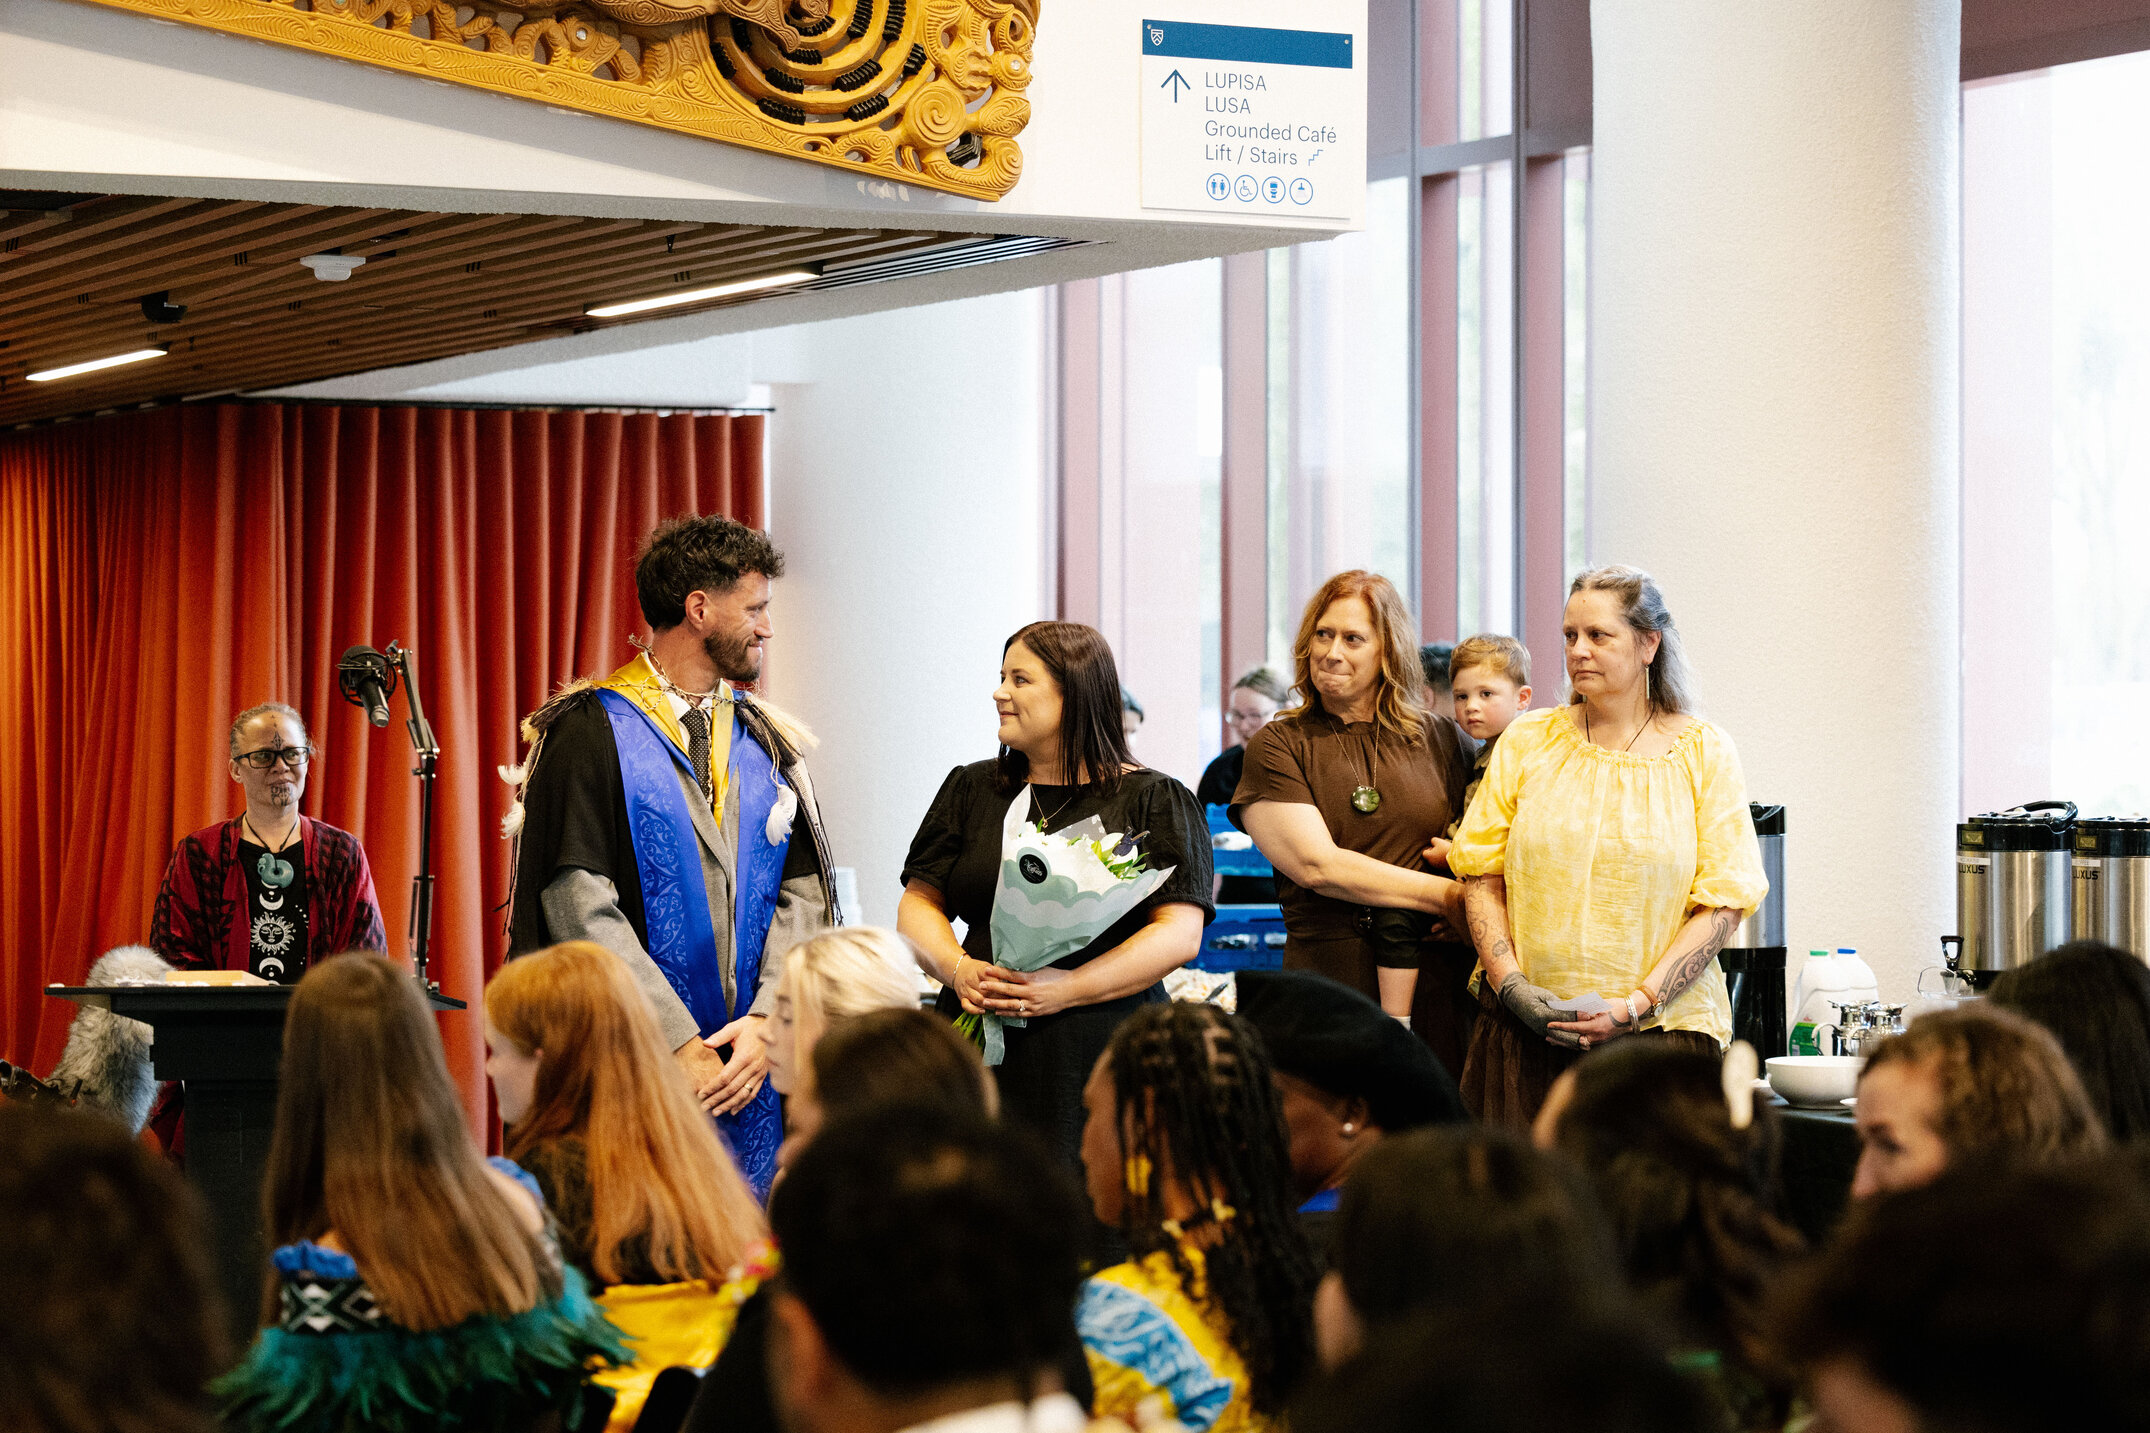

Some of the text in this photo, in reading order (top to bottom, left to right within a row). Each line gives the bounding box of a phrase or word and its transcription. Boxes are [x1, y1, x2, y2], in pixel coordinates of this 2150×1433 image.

[1205, 71, 1267, 91] LUPISA
[1205, 95, 1251, 114] LUSA
[1205, 120, 1337, 144] Grounded Café
[1205, 143, 1298, 166] Lift / Stairs
